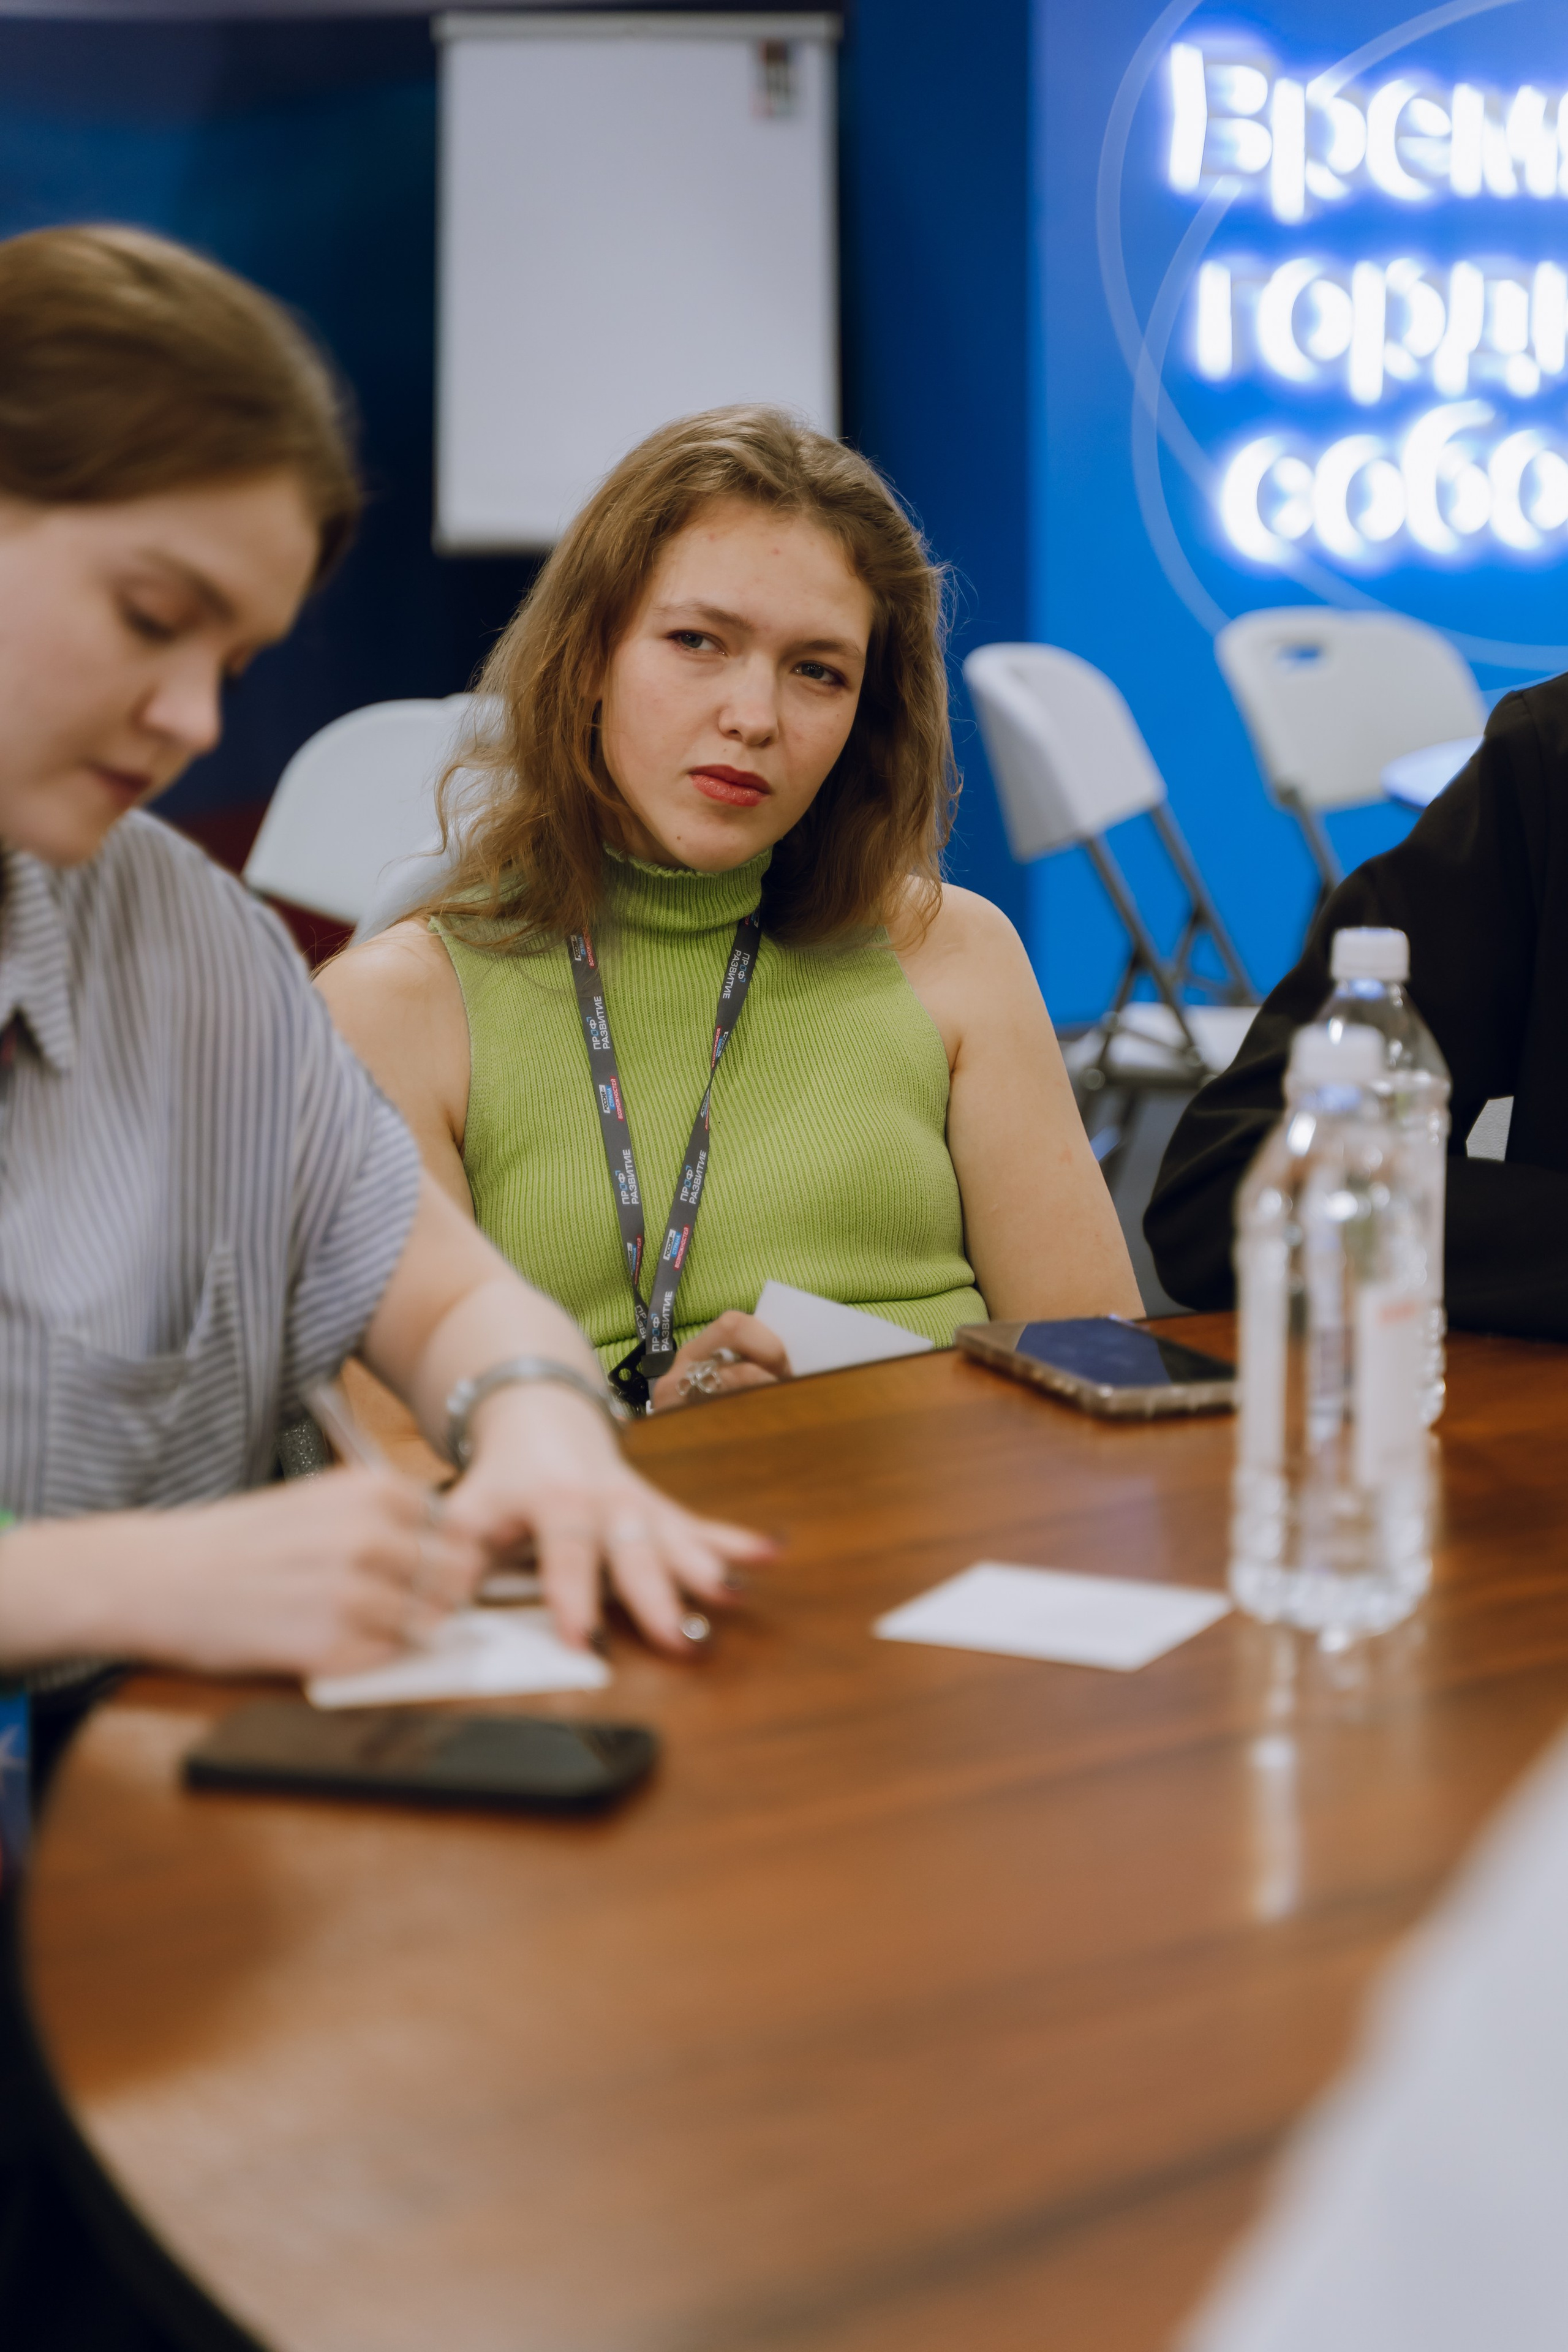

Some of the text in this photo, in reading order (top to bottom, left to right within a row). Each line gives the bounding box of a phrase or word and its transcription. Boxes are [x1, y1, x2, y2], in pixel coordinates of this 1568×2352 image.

[1169, 42, 1568, 223] Врем
[723, 949, 742, 999] РАЗВИТИЕ
[737, 952, 750, 979] ПРОФ
[589, 1019, 601, 1050] ПРОФ
[594, 996, 610, 1049] РАЗВИТИЕ
[610, 1079, 623, 1119] ВОЗМОЖНОСТЕЙ
[618, 1173, 630, 1205] ПРОФ
[622, 1149, 639, 1204] РАЗВИТИЕ
[680, 1169, 693, 1202] ПРОФ
[688, 1150, 706, 1204] РАЗВИТИЕ
[672, 1235, 680, 1254] СТРАНА
[674, 1227, 689, 1268] ВОЗМОЖНОСТЕЙ
[652, 1316, 661, 1352] ПРОФ
[662, 1291, 673, 1351] РАЗВИТИЕ
